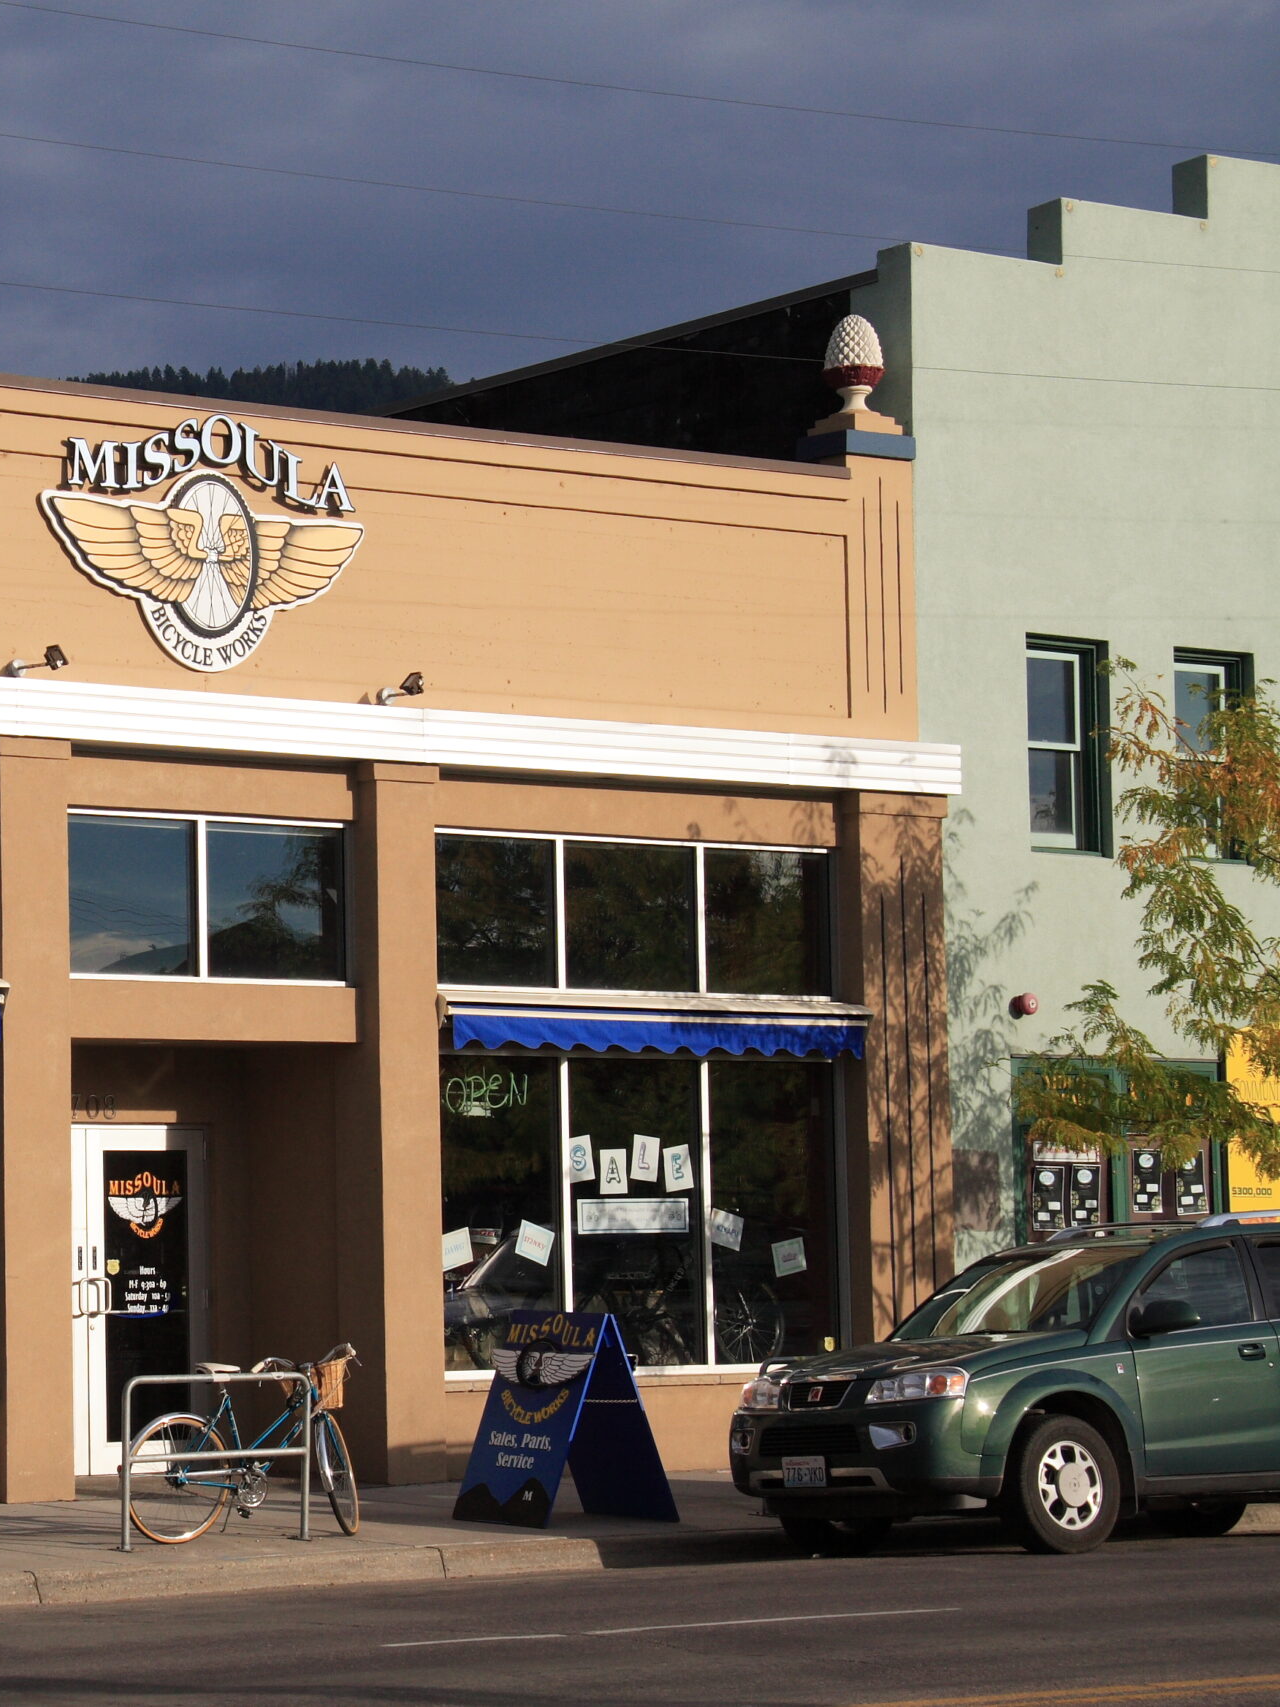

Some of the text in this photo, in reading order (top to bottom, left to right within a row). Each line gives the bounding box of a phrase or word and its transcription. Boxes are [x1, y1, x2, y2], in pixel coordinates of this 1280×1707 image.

[68, 414, 356, 512] MISSOULA
[151, 605, 268, 667] BICYCLE WORKS
[446, 1072, 528, 1113] OPEN
[570, 1141, 684, 1184] SALE
[109, 1171, 180, 1195] MISSOULA
[506, 1313, 596, 1347] MISSOULA
[501, 1387, 570, 1425] BICYCLE WORKS
[488, 1430, 552, 1452] Sales, Parts,
[495, 1451, 535, 1470] Service
